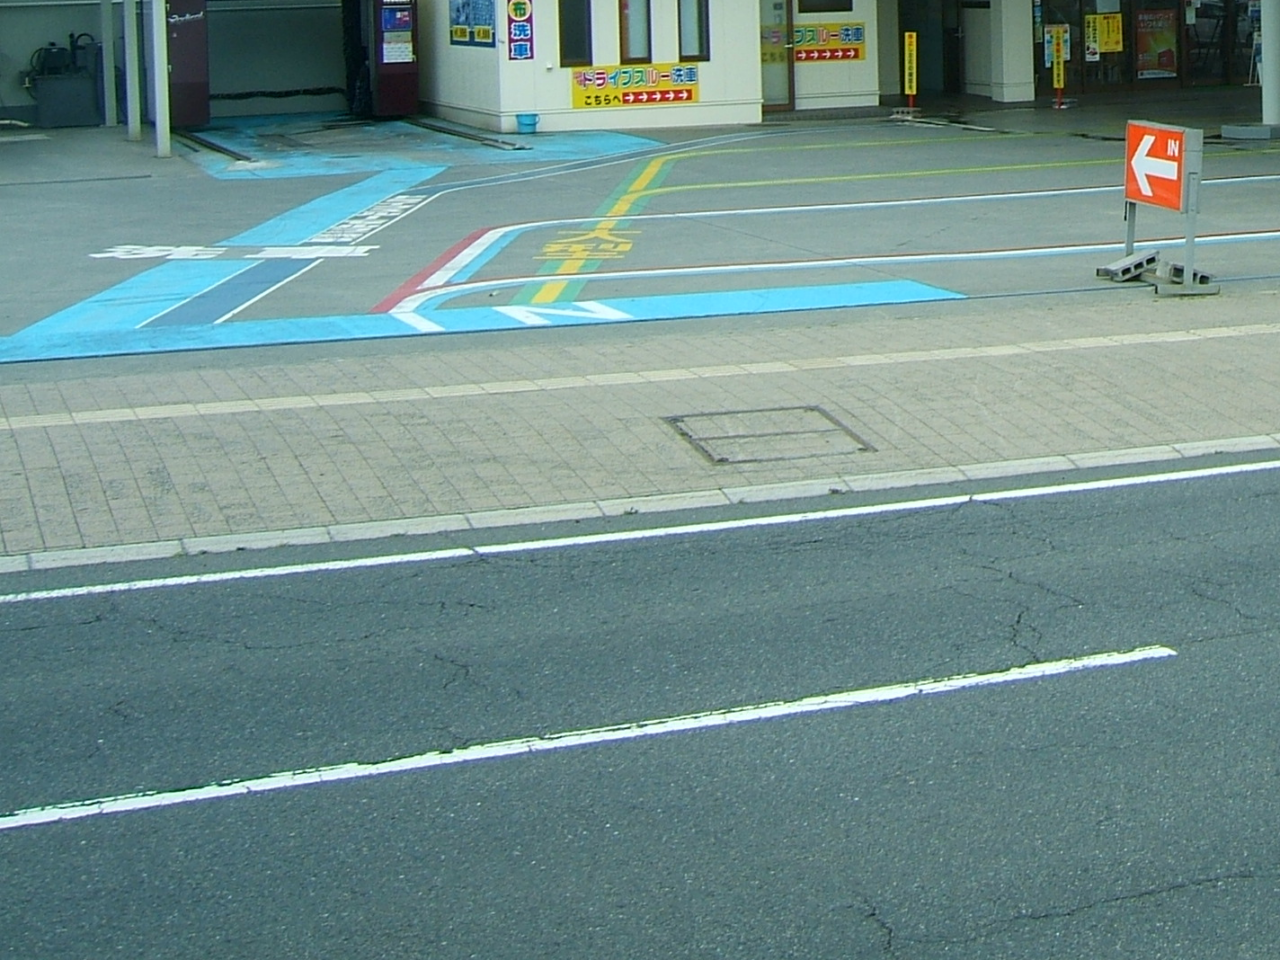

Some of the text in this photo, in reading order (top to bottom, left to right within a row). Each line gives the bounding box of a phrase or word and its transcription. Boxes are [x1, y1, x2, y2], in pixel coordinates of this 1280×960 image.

[582, 66, 698, 90] ドライブスルー洗車
[585, 95, 622, 106] こちらへ
[1167, 138, 1179, 157] IN
